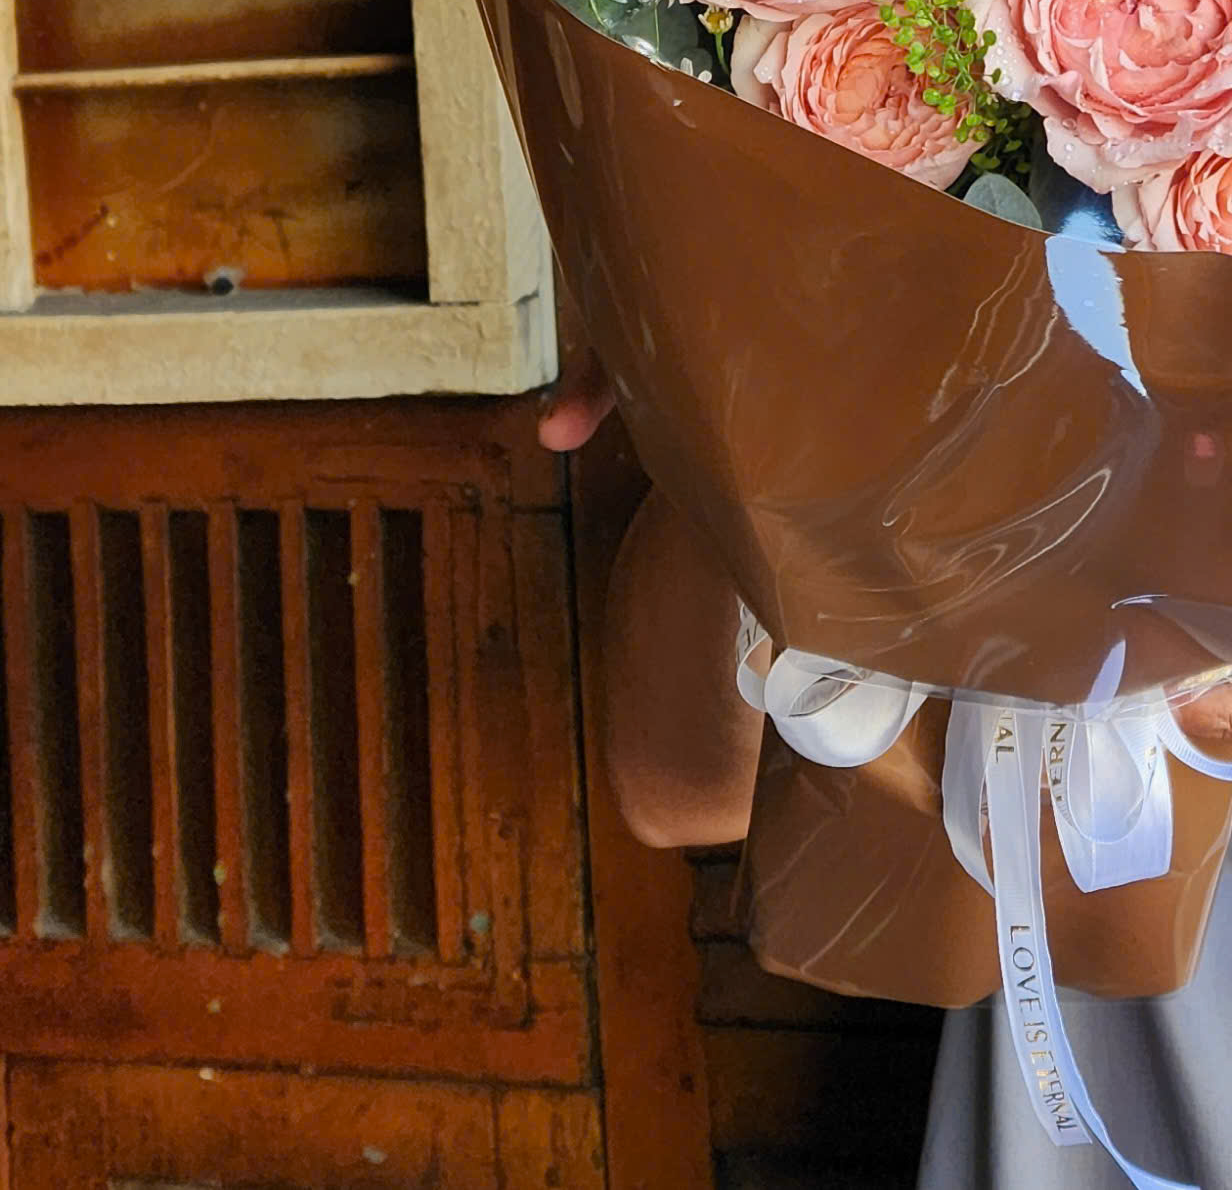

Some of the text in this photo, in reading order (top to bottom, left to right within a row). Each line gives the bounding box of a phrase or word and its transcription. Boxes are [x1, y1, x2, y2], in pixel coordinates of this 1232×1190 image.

[1009, 924, 1079, 1133] LOVE IS ETERNAL
